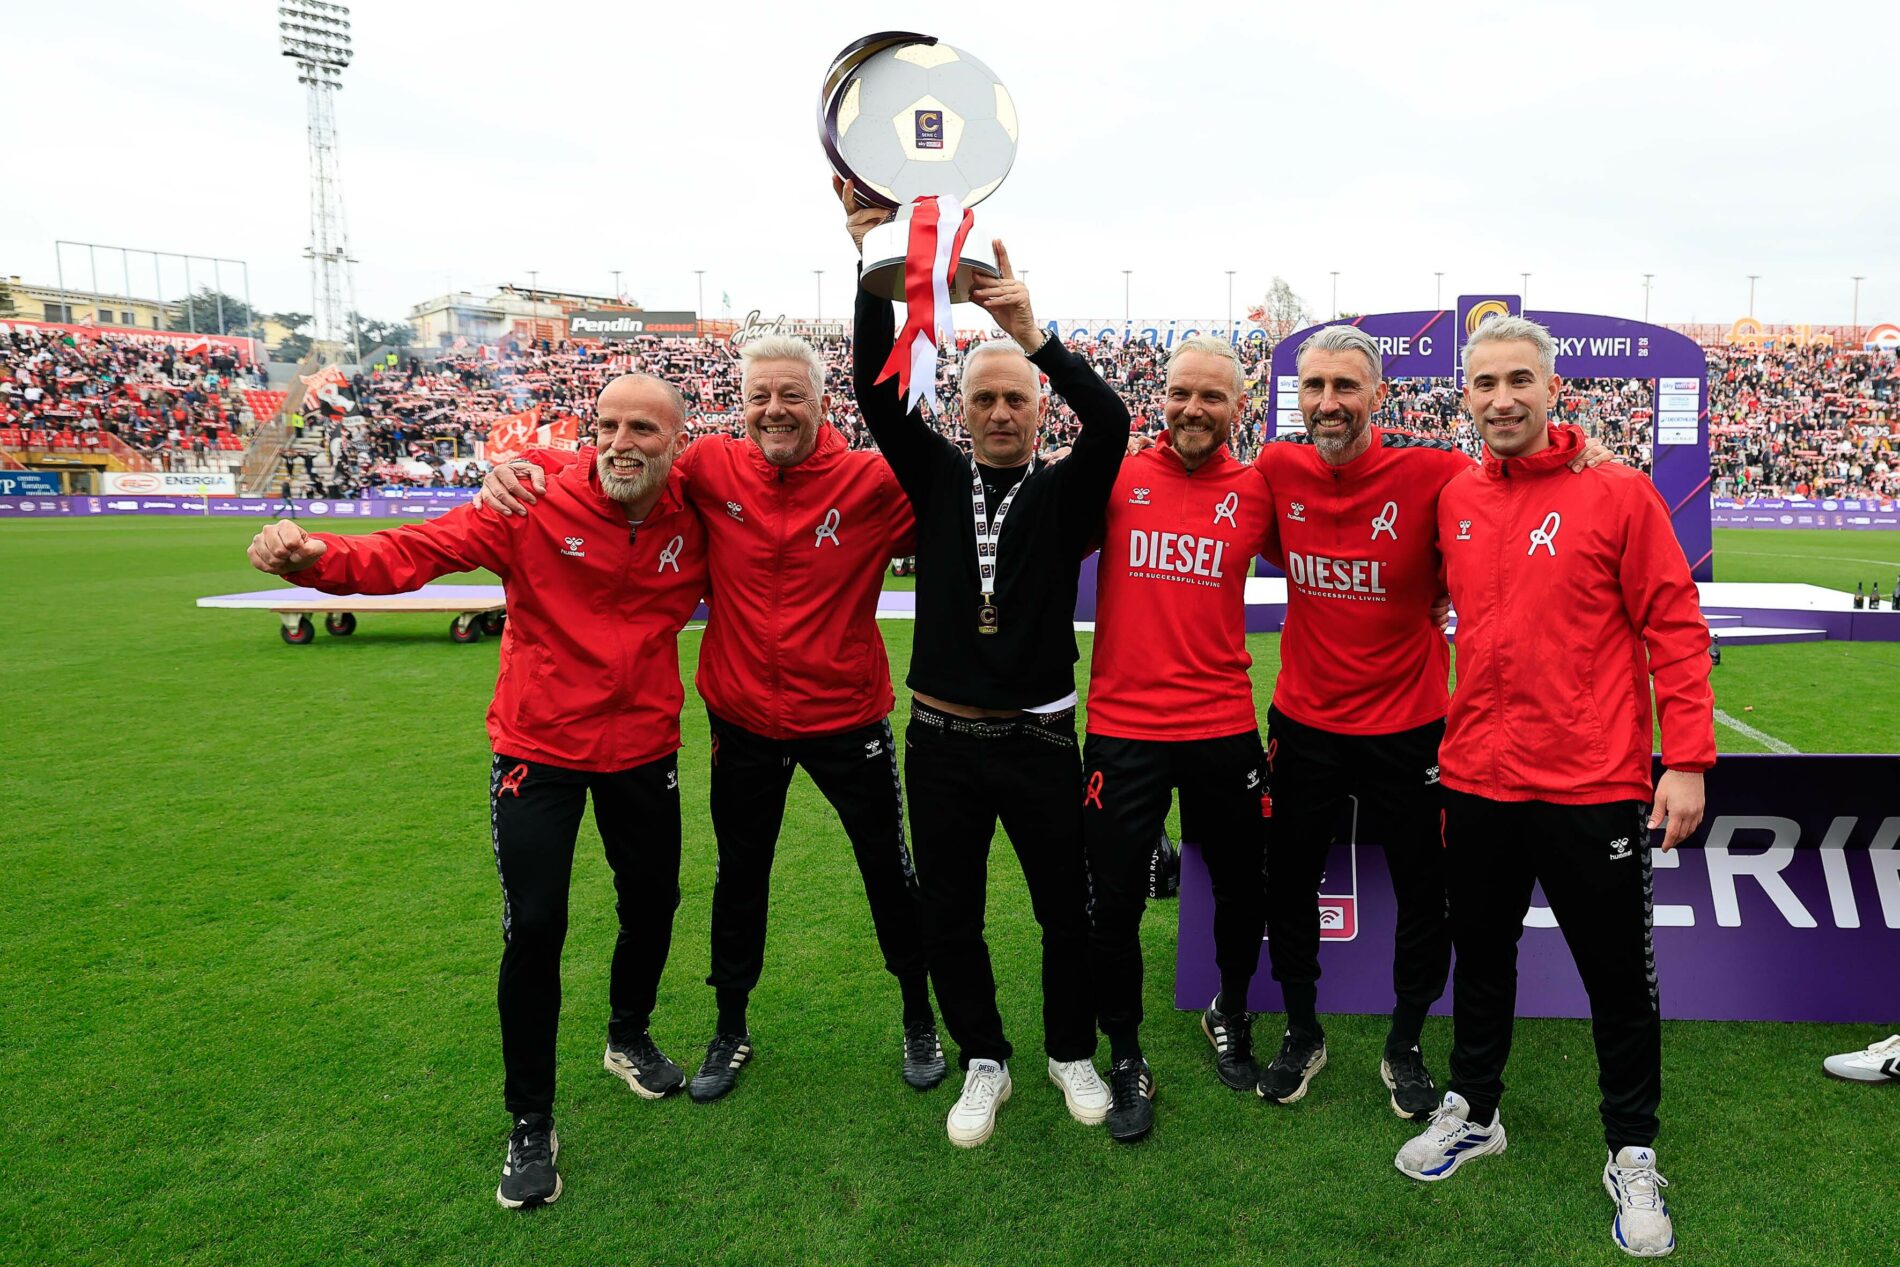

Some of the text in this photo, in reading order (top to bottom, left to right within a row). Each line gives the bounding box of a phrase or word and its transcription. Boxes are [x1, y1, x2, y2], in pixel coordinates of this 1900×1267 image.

[570, 317, 695, 332] Pendin GOMME
[1371, 336, 1433, 356] RIE C
[1551, 337, 1631, 357] SKY WIFI
[165, 476, 226, 486] ENERGIA
[560, 548, 585, 557] hummel
[1129, 529, 1223, 578] DIESEL
[1289, 551, 1386, 594] DIESEL
[1145, 573, 1196, 584] SUCCESSFUL
[1197, 580, 1221, 588] LIVING
[1308, 590, 1357, 600] SUCCESSFUL
[1609, 848, 1633, 860] hummel
[978, 1064, 995, 1074] DIESEL
